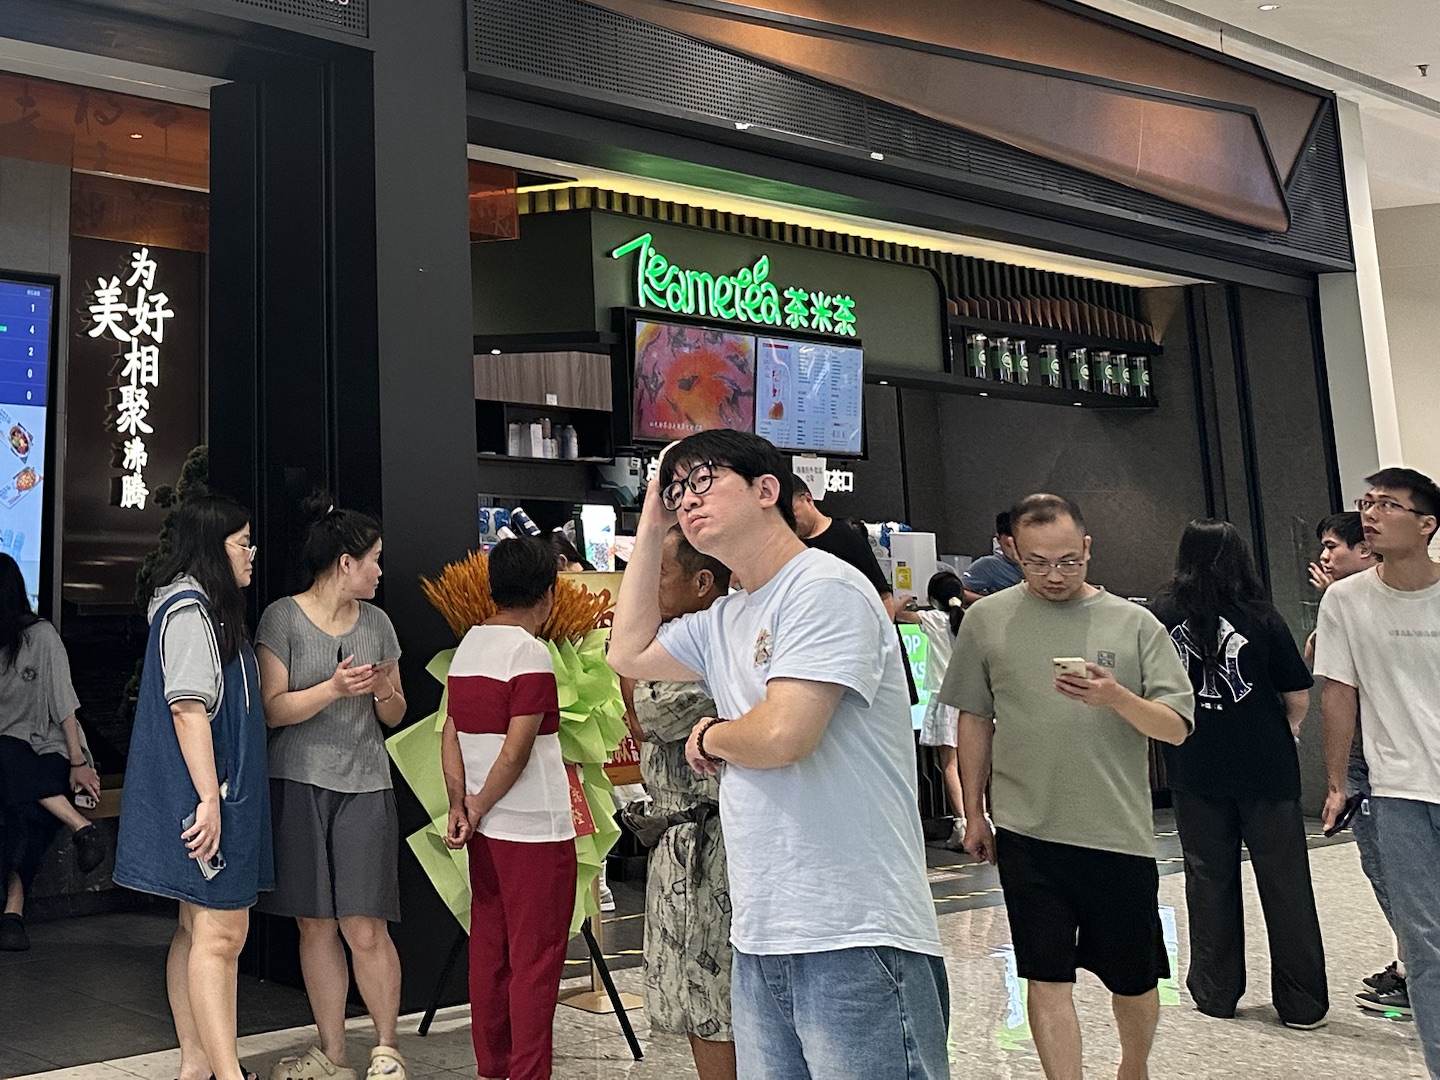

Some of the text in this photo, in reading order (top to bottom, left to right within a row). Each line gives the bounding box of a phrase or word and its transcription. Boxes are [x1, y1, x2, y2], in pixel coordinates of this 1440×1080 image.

[30, 303, 35, 313] 1
[783, 286, 857, 338] 茶米茶
[29, 324, 35, 335] 4
[28, 346, 34, 357] 2
